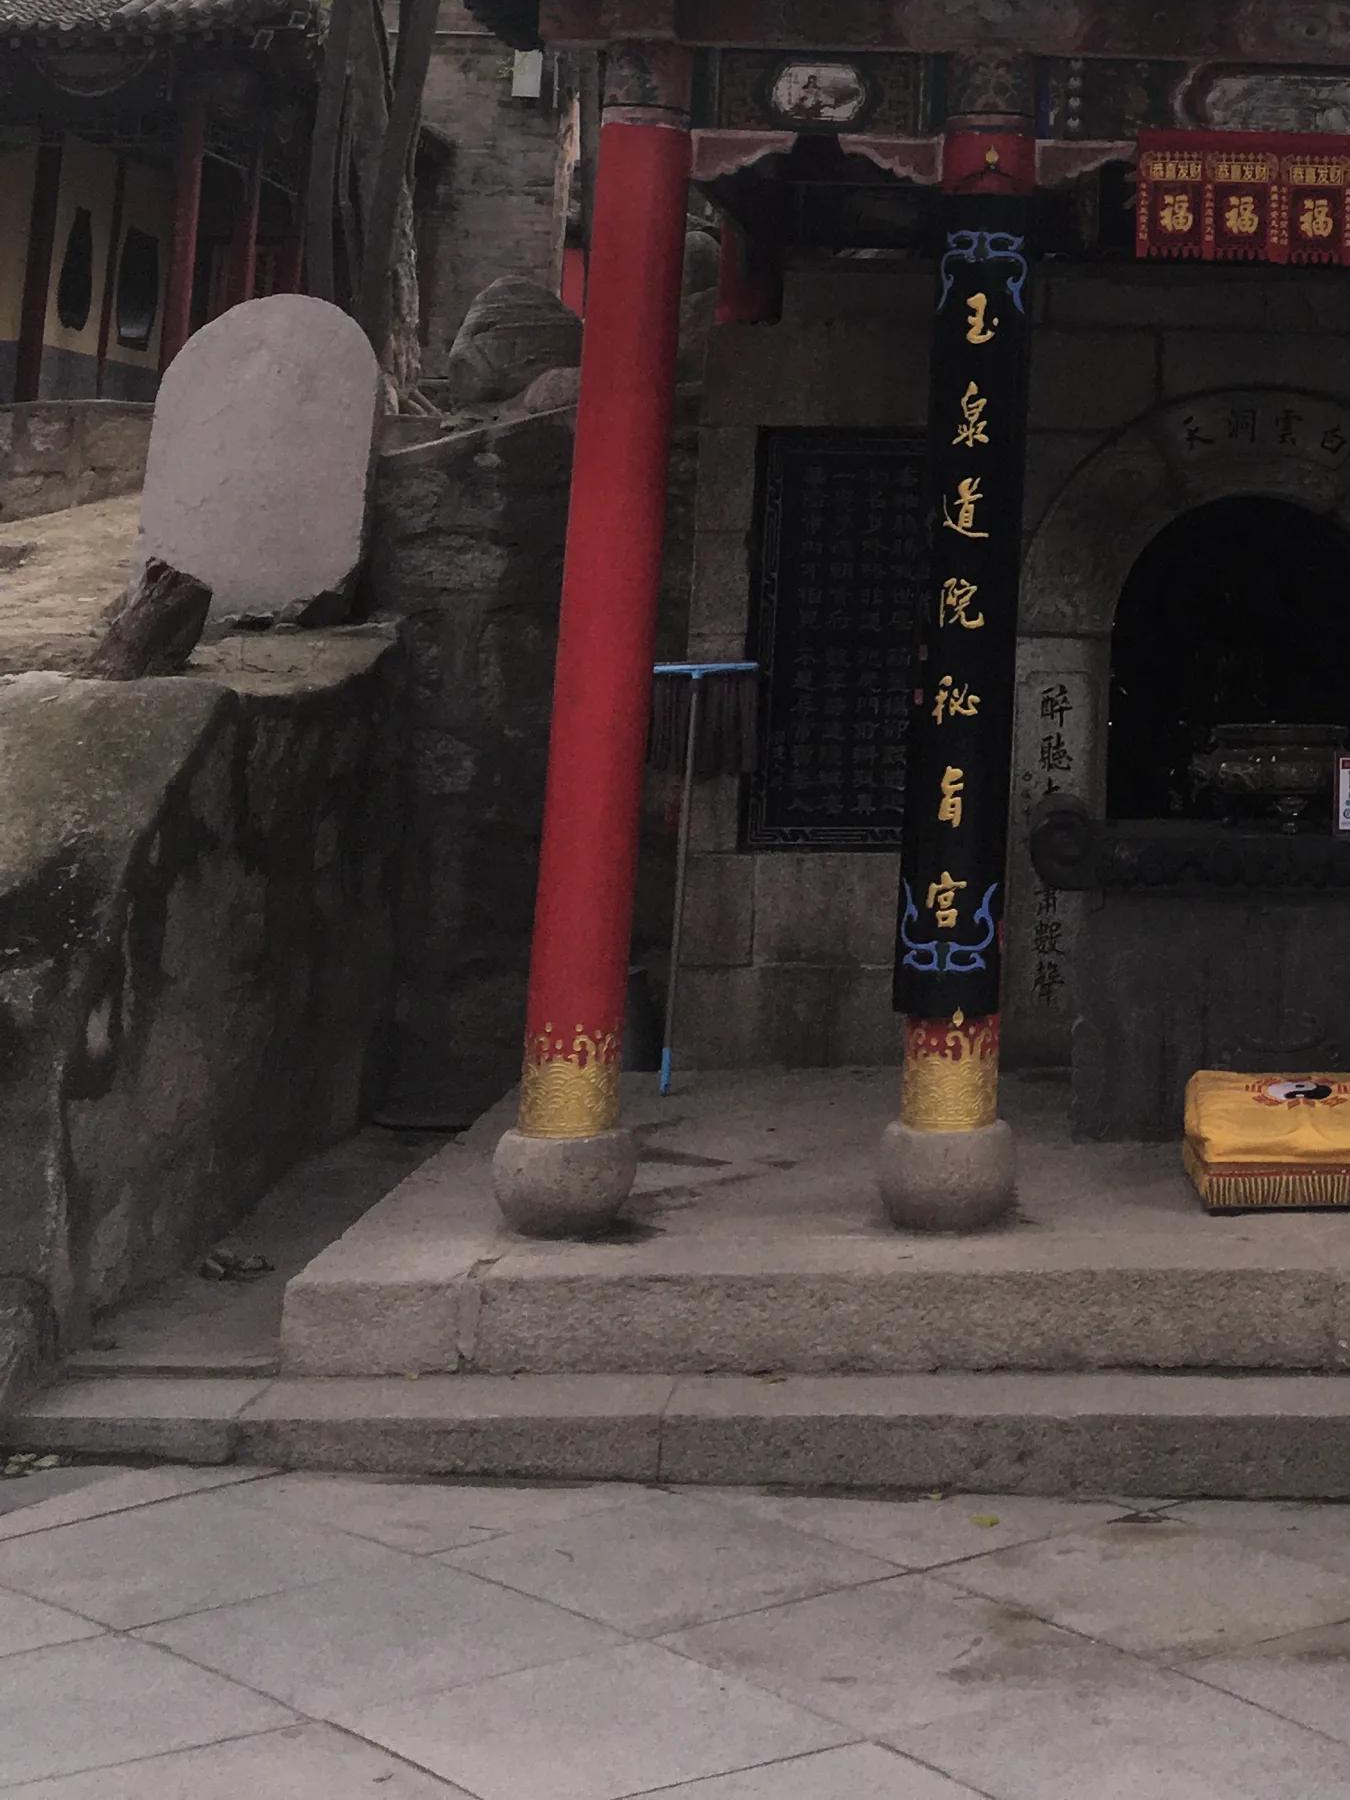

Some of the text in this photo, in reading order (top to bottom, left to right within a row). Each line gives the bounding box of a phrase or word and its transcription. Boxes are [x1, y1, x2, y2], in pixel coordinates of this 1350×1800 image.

[1151, 161, 1202, 179] 恭喜发财
[1217, 163, 1269, 181] 恭喜发财
[1292, 166, 1342, 184] 恭喜发财
[1160, 193, 1194, 233] 福
[1224, 195, 1259, 235] 福
[1299, 198, 1334, 238] 福
